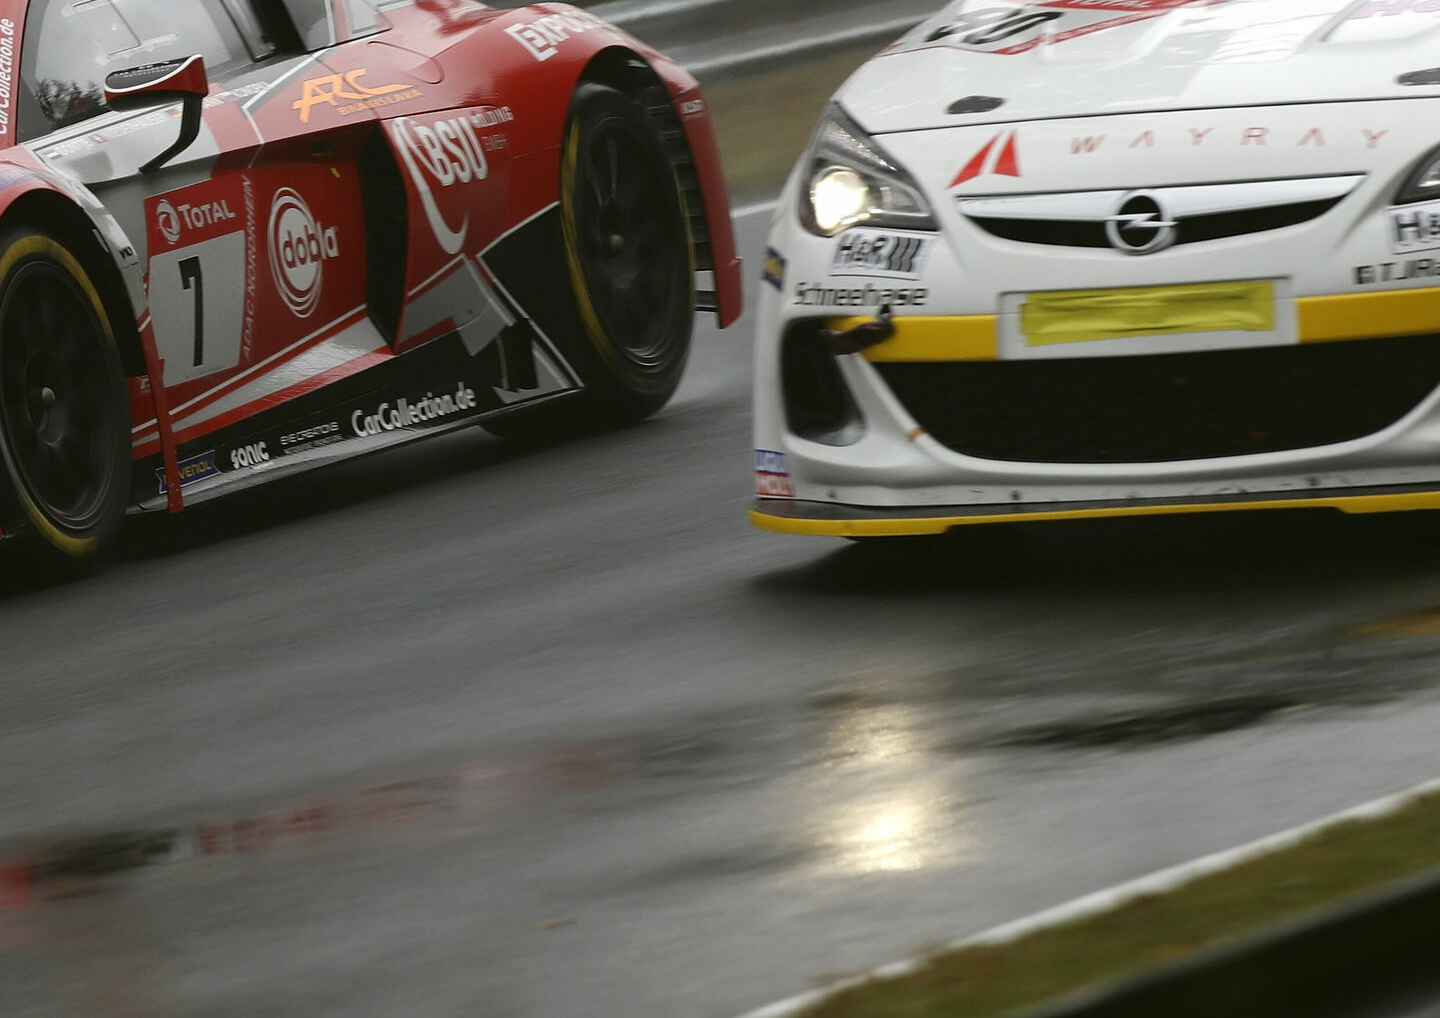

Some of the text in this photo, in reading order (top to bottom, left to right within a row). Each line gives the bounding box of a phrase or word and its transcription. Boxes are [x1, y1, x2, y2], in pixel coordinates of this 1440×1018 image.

[336, 89, 425, 116] BRATISLAVA
[416, 116, 489, 186] BSU
[241, 174, 257, 361] ADAC NORDRHEIN
[282, 220, 340, 270] dobla
[178, 254, 204, 368] 7
[351, 382, 477, 437] CarCollection.de
